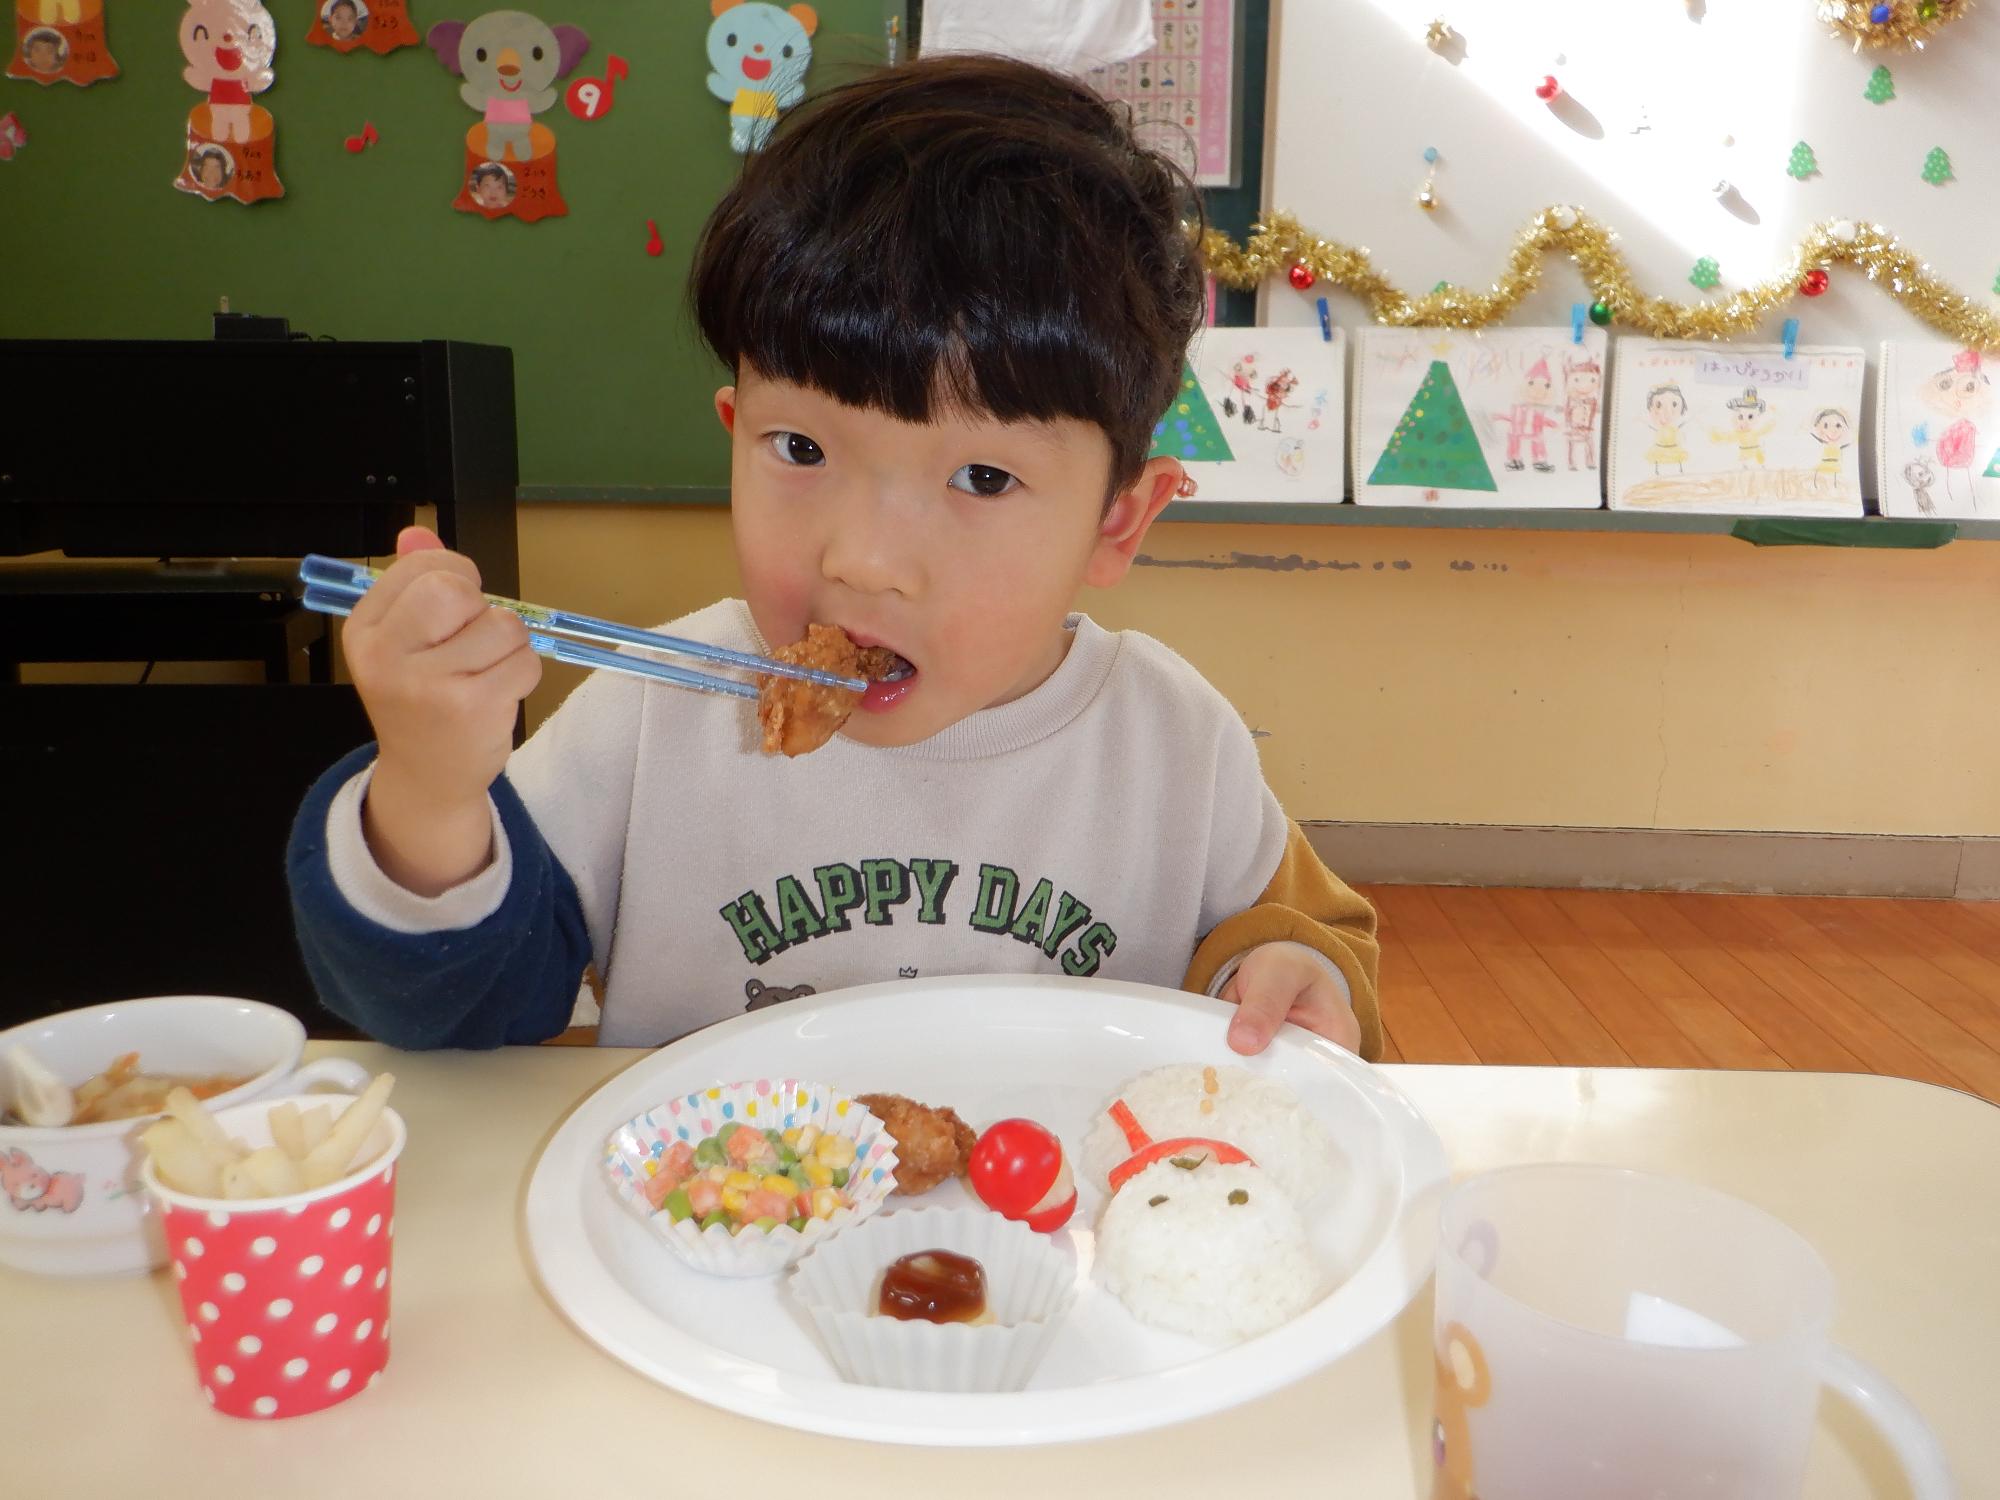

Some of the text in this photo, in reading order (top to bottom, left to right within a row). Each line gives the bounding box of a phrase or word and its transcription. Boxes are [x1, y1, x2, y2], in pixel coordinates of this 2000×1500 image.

[1184, 23, 1198, 36] い
[578, 83, 601, 117] 9
[719, 858, 1118, 978] HAPPY DAYS
